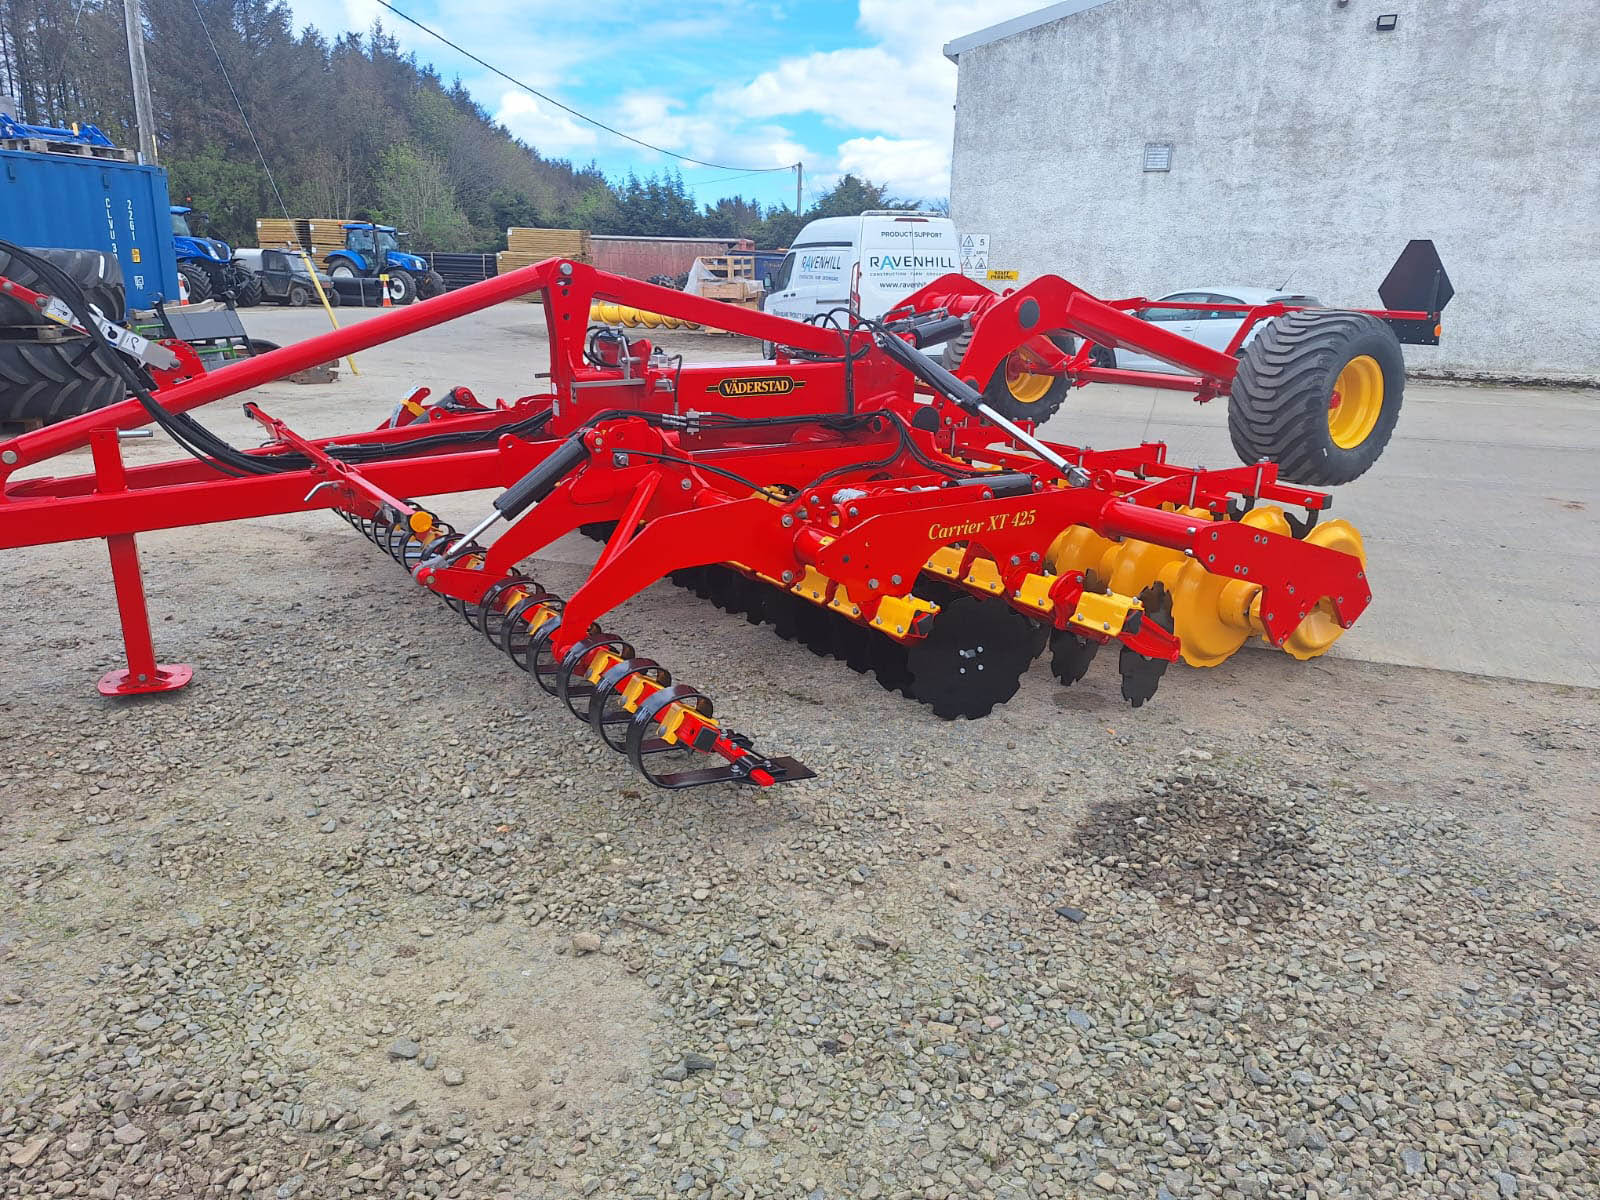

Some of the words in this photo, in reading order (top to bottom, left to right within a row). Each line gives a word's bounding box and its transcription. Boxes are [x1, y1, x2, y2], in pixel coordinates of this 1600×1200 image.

[979, 238, 985, 246] 5
[802, 256, 841, 271] RAVENHILL
[869, 255, 956, 270] RAVENHILL
[724, 378, 790, 395] VÄDERSTAD
[928, 519, 985, 540] Carrier
[987, 513, 1010, 532] XT
[1011, 509, 1037, 527] 425
